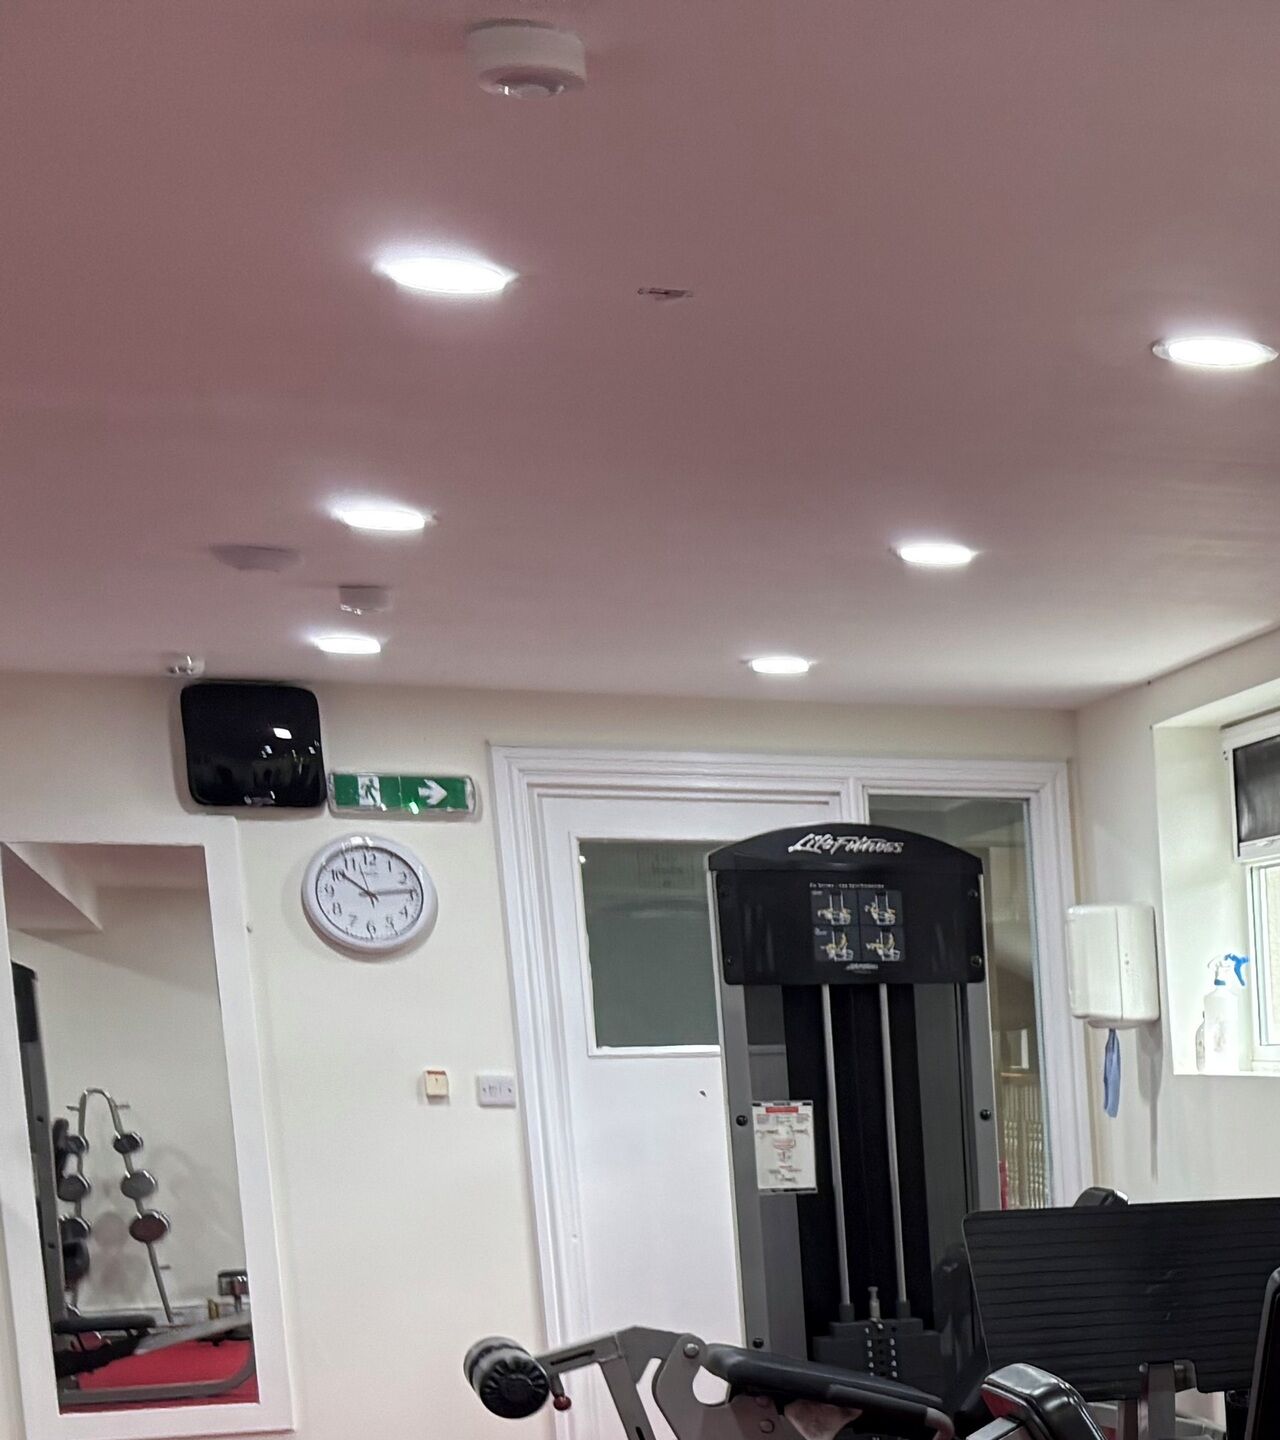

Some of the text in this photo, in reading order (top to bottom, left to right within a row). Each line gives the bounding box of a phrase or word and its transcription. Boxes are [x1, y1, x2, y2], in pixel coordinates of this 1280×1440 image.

[344, 856, 356, 872] 11
[362, 851, 377, 867] 12
[387, 859, 392, 873] 1
[399, 870, 408, 885] 2
[324, 884, 335, 898] 9
[399, 905, 409, 920] 4
[348, 914, 358, 928] 7
